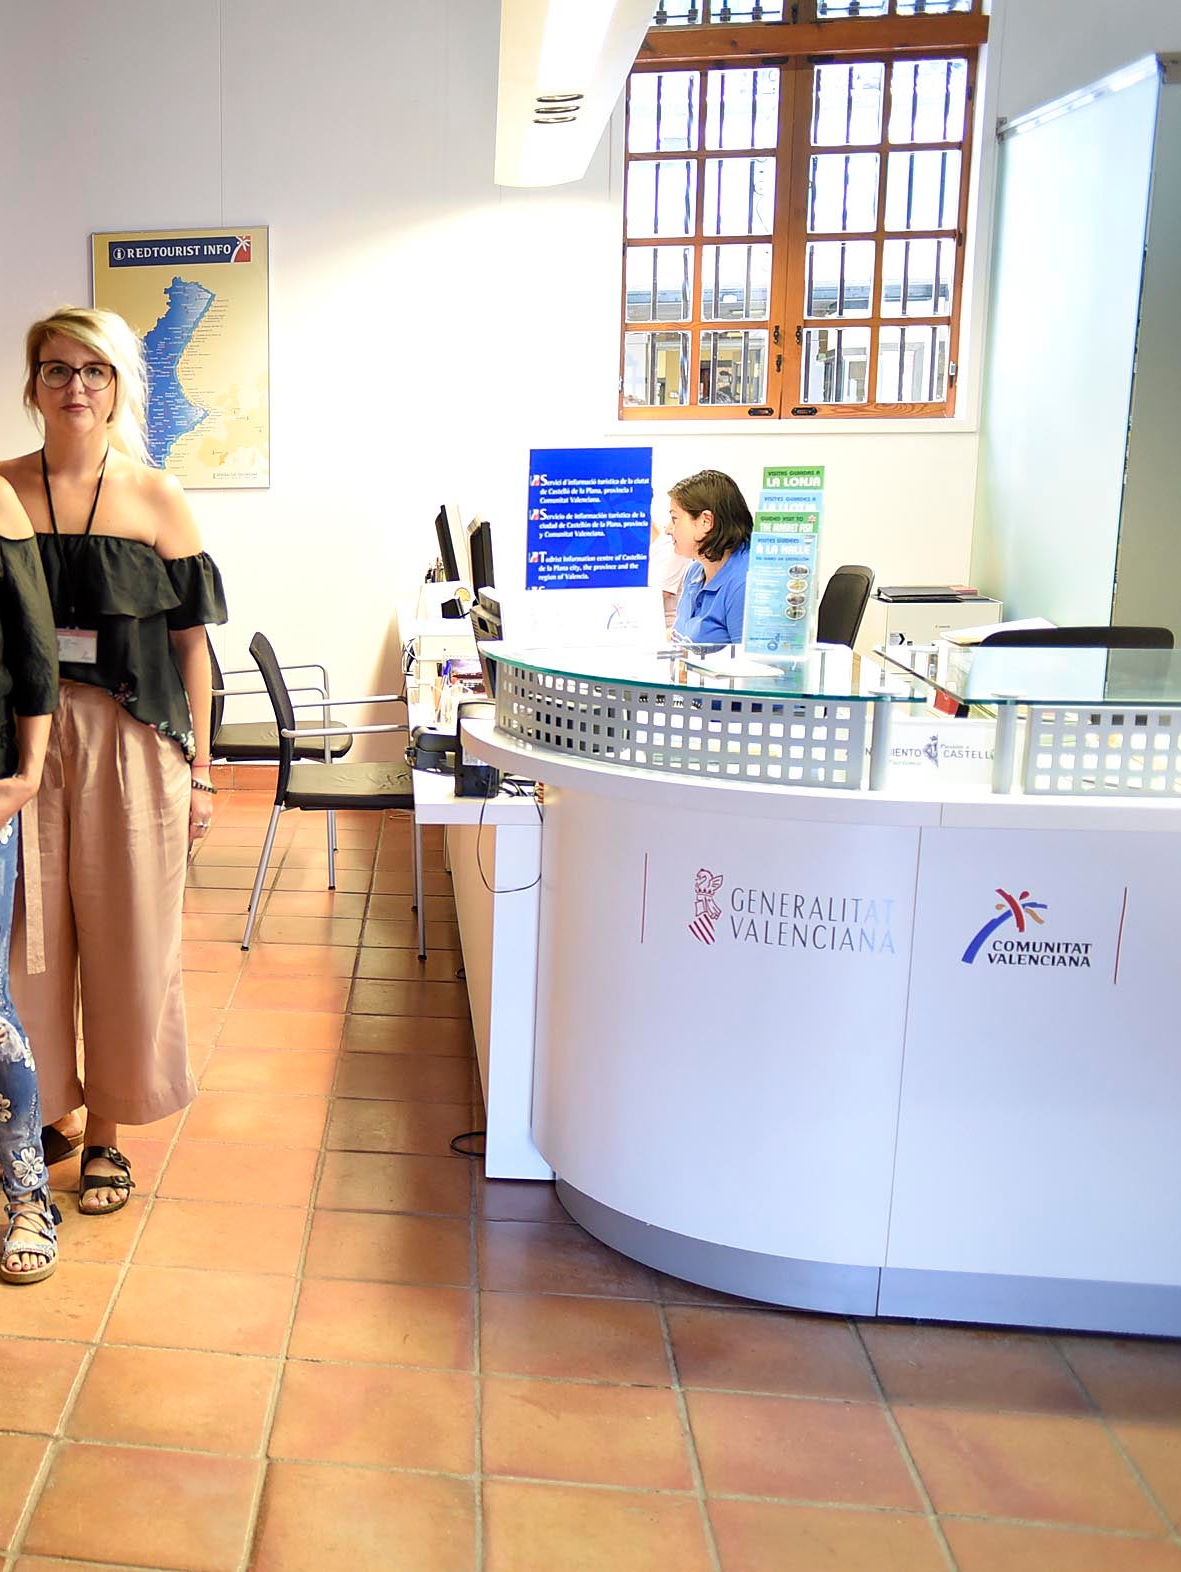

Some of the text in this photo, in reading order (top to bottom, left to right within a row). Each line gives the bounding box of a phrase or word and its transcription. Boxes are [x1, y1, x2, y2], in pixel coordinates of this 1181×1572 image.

[204, 244, 232, 255] INFO
[766, 477, 820, 486] LA LONJA
[731, 888, 895, 924] GENERALITAT
[730, 915, 895, 954] VALENCIANA
[992, 940, 1092, 955] COMUNITAT
[987, 953, 1091, 967] VALENCIANA
